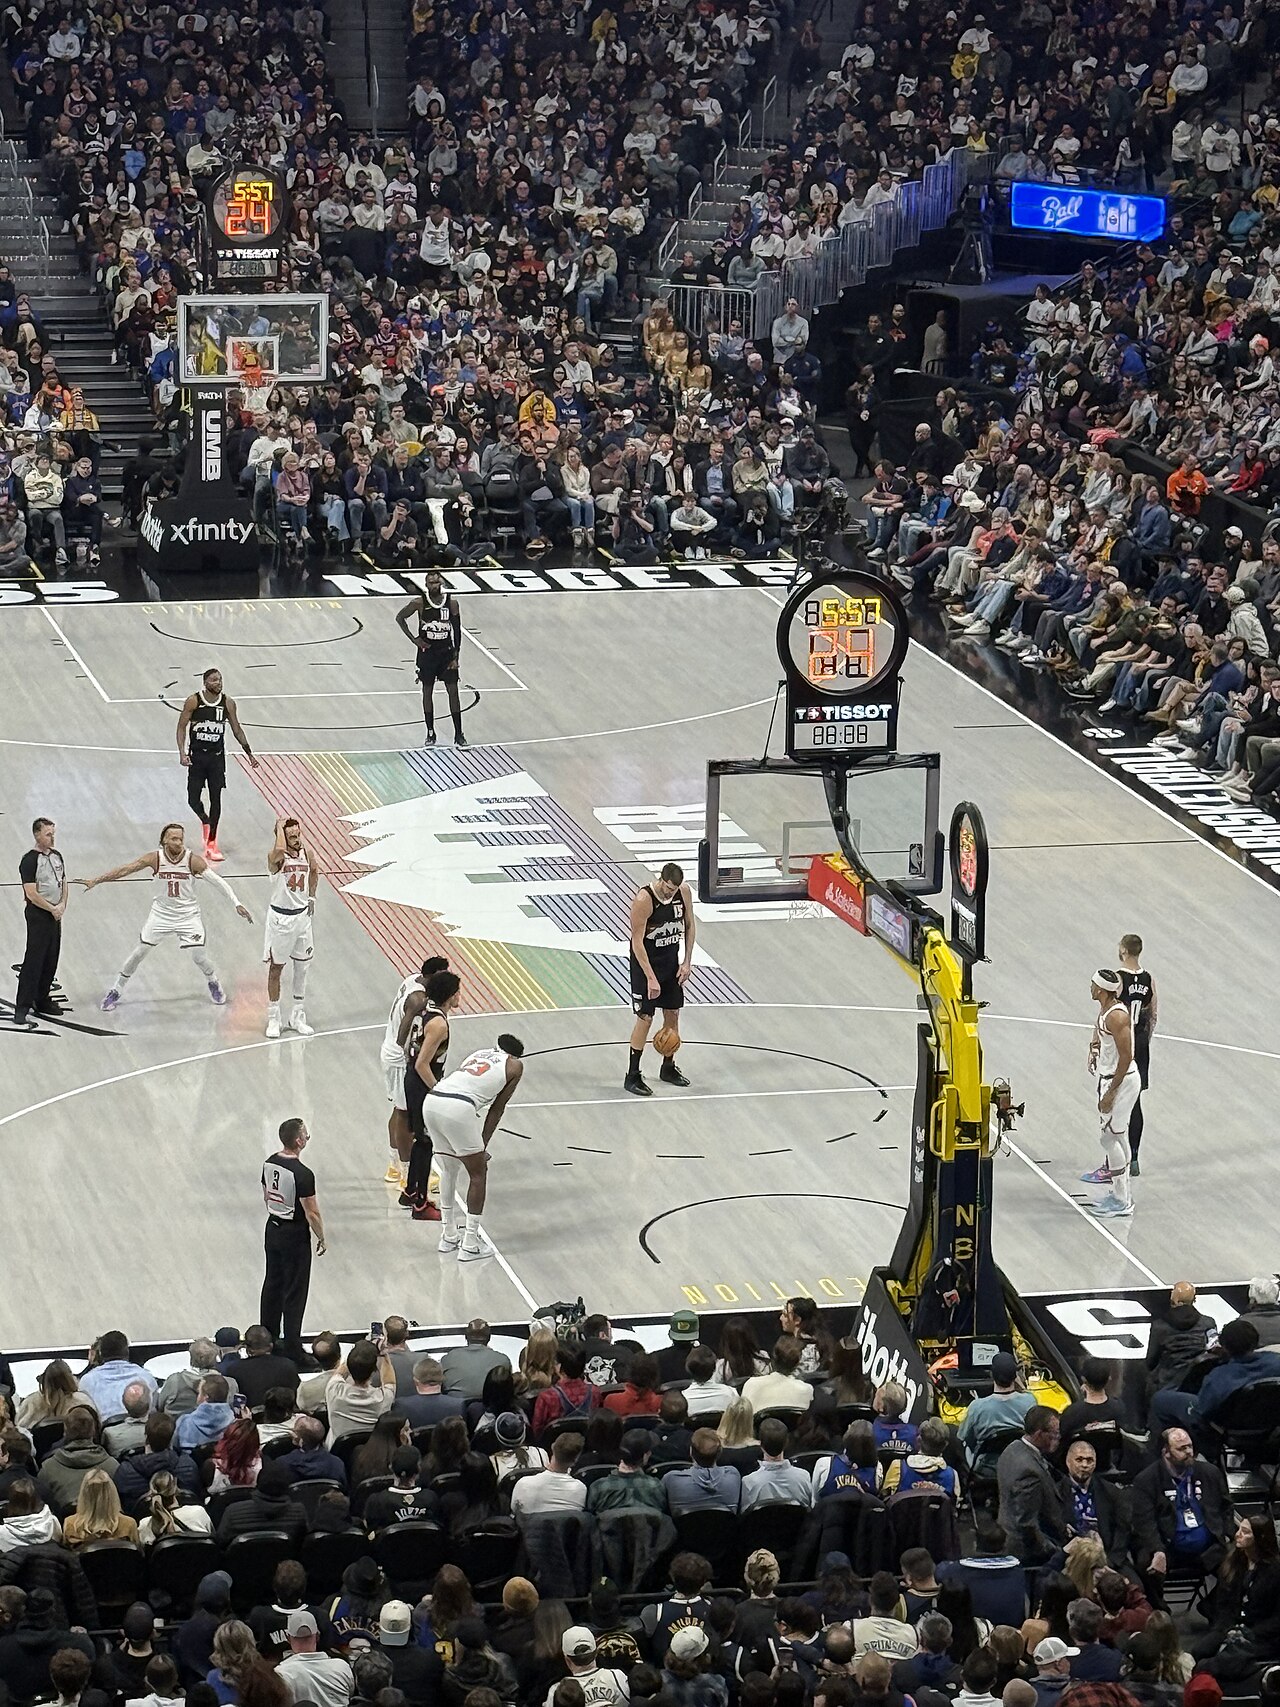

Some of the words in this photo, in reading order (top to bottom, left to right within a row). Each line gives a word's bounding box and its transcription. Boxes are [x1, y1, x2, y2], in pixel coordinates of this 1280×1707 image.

[234, 182, 273, 201] 5:57
[225, 201, 271, 235] 24
[1042, 195, 1084, 227] Ball
[206, 410, 222, 482] UMB
[170, 517, 254, 545] xfinity
[323, 562, 812, 597] NUGGETS
[822, 598, 881, 627] 5:57
[821, 705, 892, 720] TISSOT
[287, 873, 304, 892] 44
